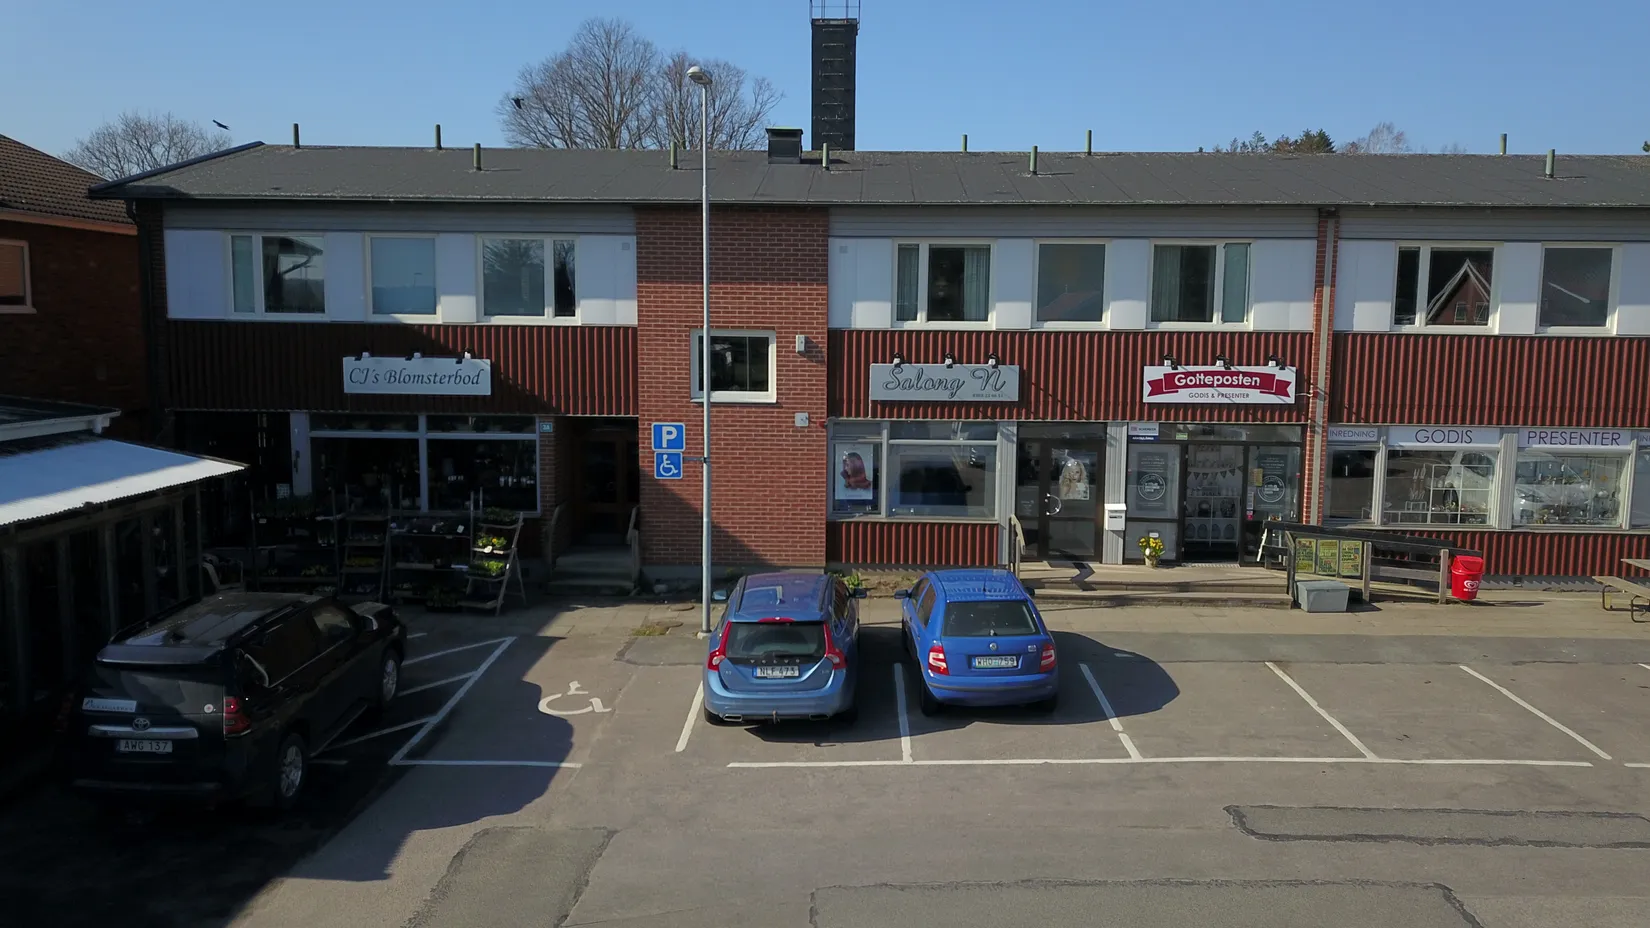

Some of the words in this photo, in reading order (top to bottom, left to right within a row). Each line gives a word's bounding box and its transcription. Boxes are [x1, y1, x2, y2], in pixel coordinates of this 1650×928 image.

[383, 367, 485, 386] Blomsterbod
[883, 367, 965, 399] Salong
[970, 367, 1007, 392] N
[1174, 373, 1260, 387] Gotteposten
[662, 426, 677, 447] P
[1329, 429, 1376, 438] INREDNING
[1414, 428, 1473, 444] GODIS
[1527, 430, 1621, 446] PRESENTER
[998, 657, 1015, 666] 759
[123, 740, 144, 751] AWG
[148, 741, 168, 751] 137
